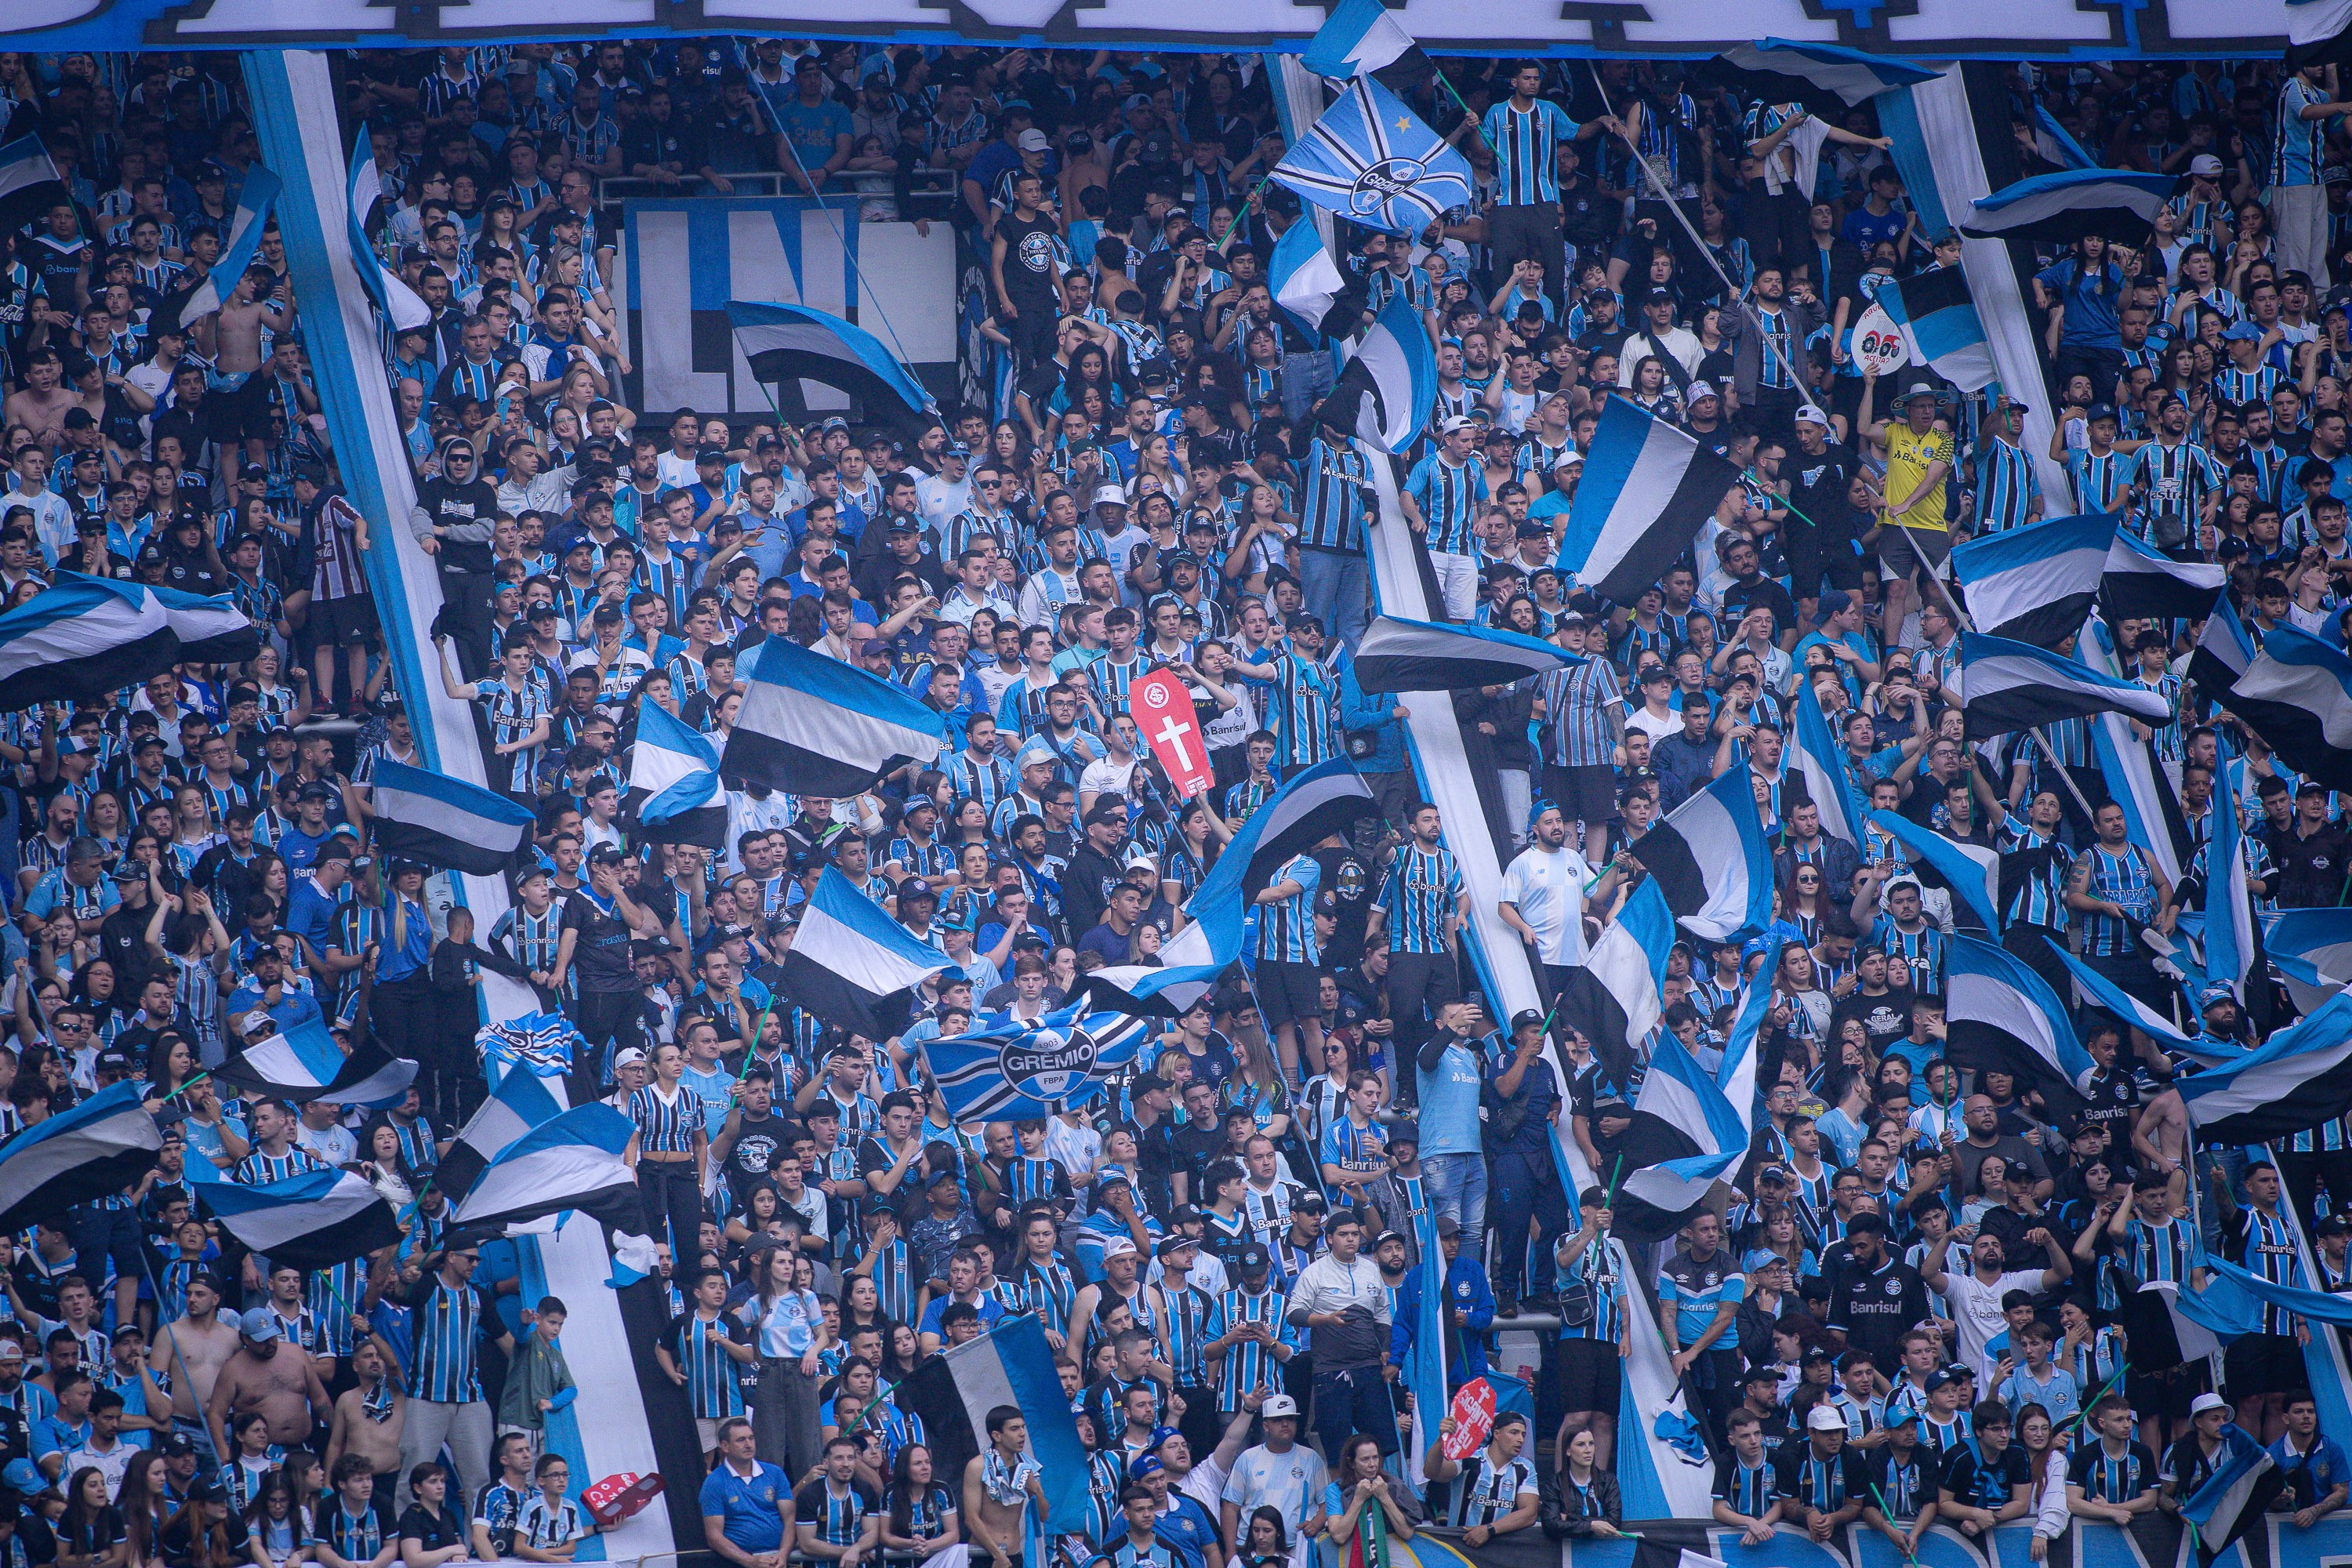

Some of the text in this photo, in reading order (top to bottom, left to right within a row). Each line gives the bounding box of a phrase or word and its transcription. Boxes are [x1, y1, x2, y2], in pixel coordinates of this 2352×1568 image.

[2186, 226, 2214, 236] banris
[1766, 332, 1792, 342] anris
[491, 710, 533, 728] Banrisu
[1210, 722, 1247, 736] Banrisul
[1421, 882, 1446, 893] banris
[524, 936, 557, 946] banrisul
[1871, 1013, 1896, 1023] GERAL
[1039, 1037, 1059, 1050] 1903
[1006, 1042, 1094, 1072] GRÊMIO
[1042, 1074, 1065, 1086] FBPA
[2083, 1104, 2129, 1121] Banrisu
[1257, 1214, 1291, 1230] Banris
[2256, 1243, 2296, 1256] banris
[1850, 1300, 1902, 1316] Banrisul
[1475, 1494, 1514, 1510] Banrisu
